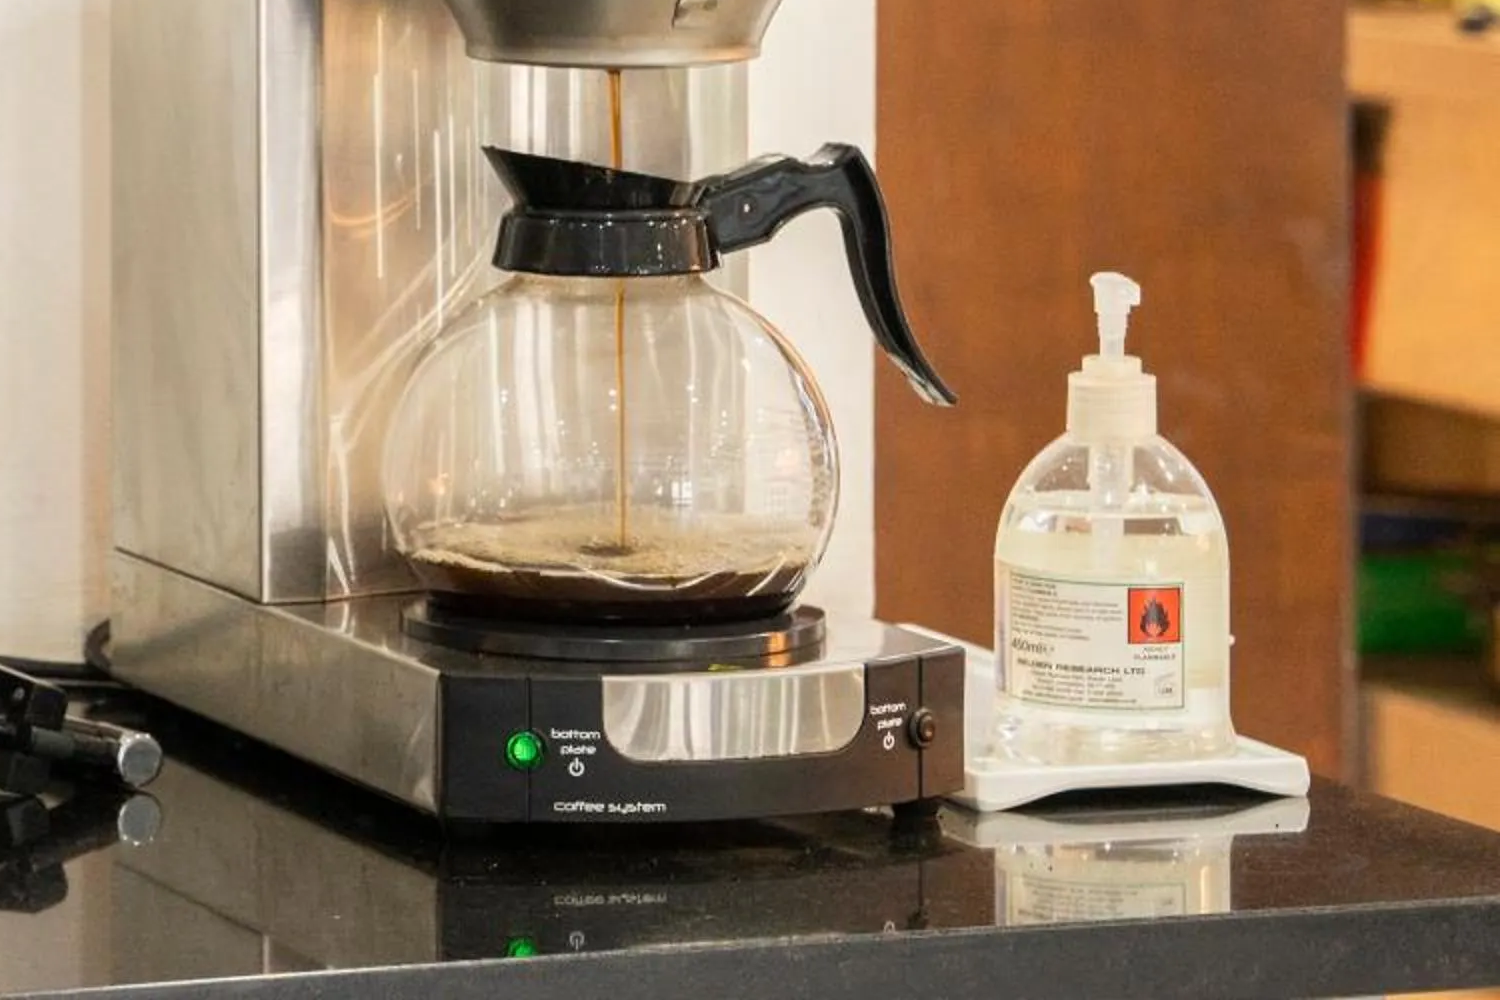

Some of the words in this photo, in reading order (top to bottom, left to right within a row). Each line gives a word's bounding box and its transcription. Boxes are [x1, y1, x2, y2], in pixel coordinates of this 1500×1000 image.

[870, 702, 907, 715] bottom
[550, 727, 601, 739] bottom
[561, 745, 597, 755] plate
[553, 801, 605, 813] coffee
[607, 801, 667, 814] system
